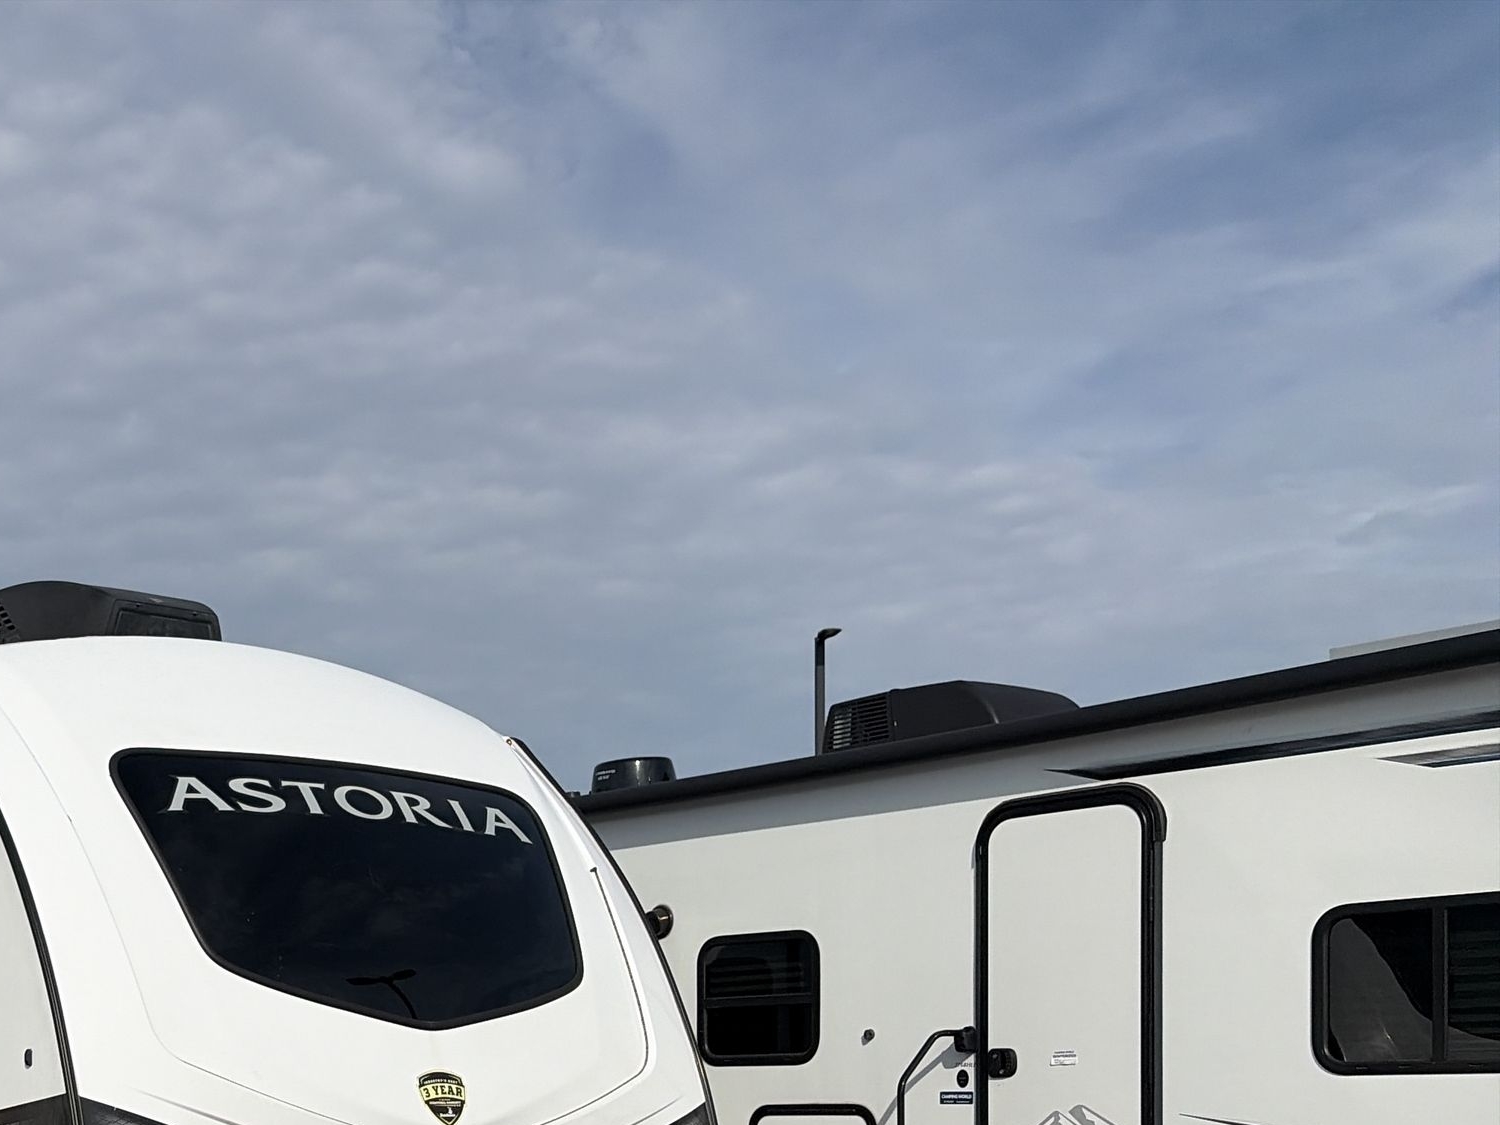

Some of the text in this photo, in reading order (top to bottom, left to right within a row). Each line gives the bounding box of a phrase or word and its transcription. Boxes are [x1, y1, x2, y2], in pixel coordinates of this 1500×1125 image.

[164, 775, 534, 845] ASTORIA
[422, 1085, 463, 1098] 3 YEAR
